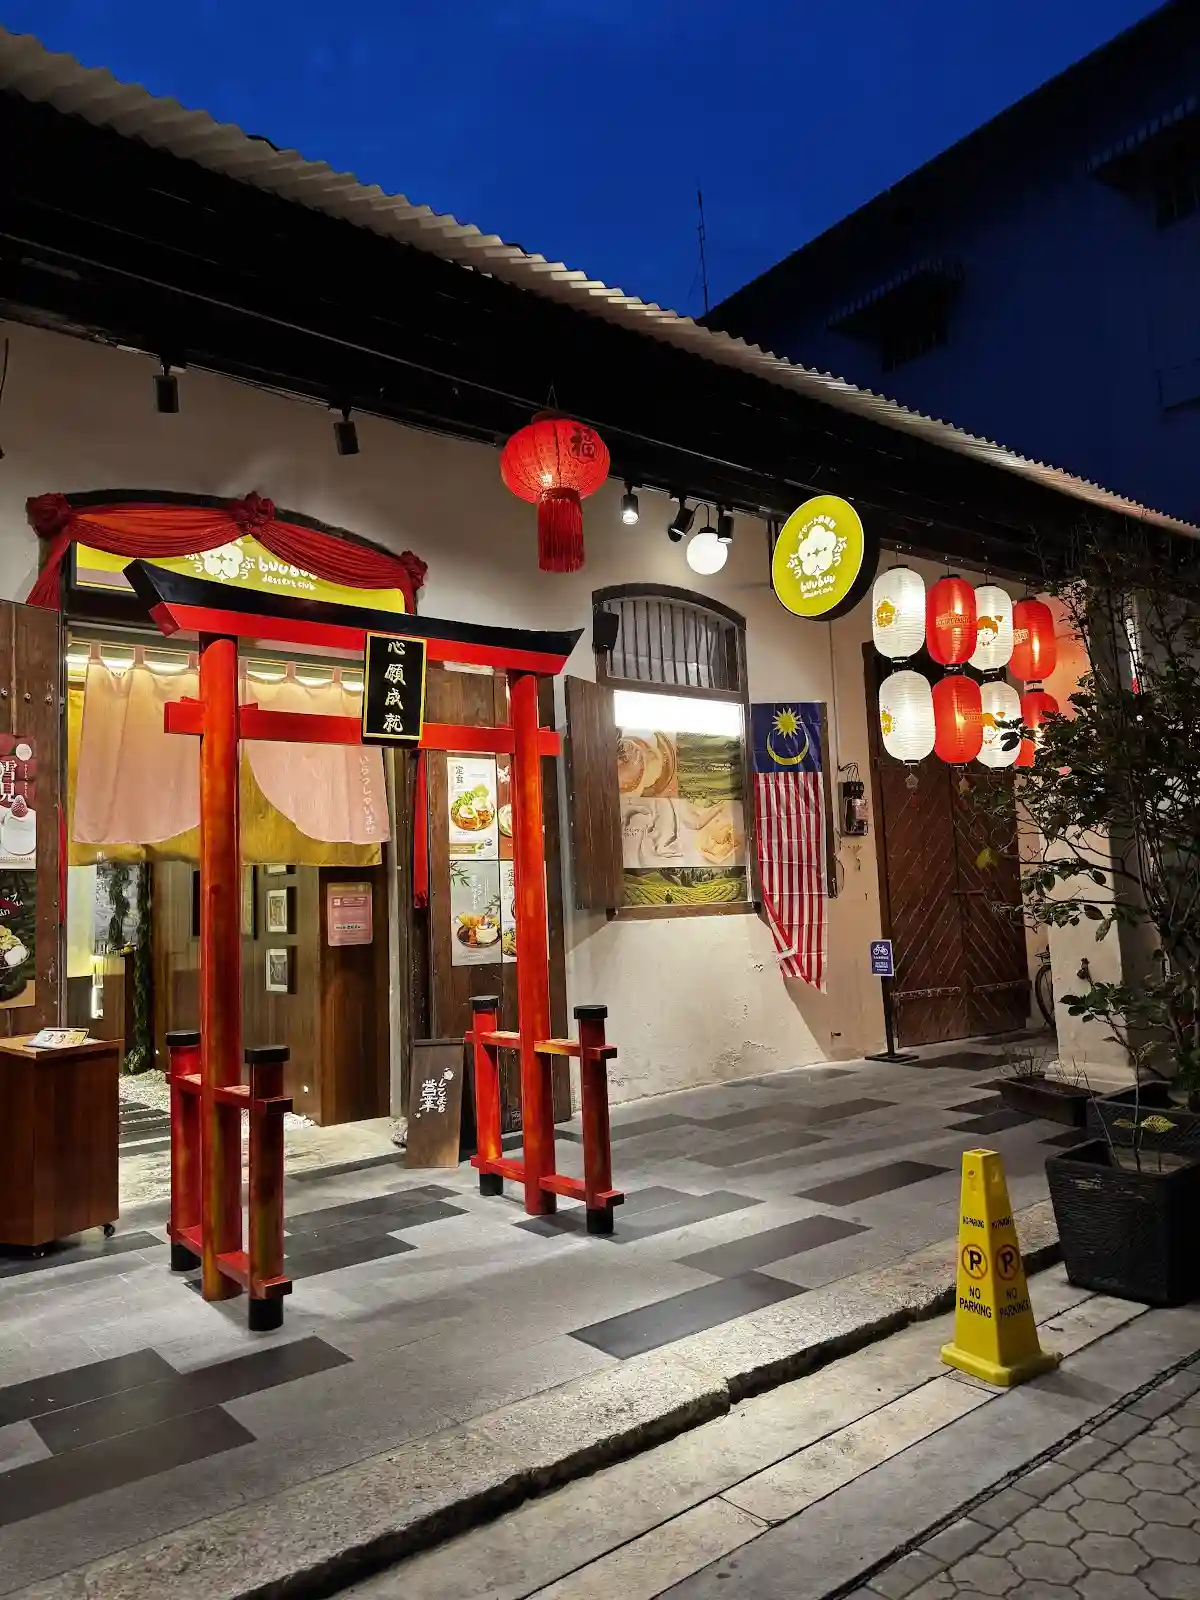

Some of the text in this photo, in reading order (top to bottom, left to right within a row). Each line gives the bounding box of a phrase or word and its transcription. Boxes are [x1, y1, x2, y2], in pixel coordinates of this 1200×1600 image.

[969, 1285, 981, 1300] NO
[1006, 1287, 1018, 1300] NO
[960, 1297, 992, 1319] PARKING
